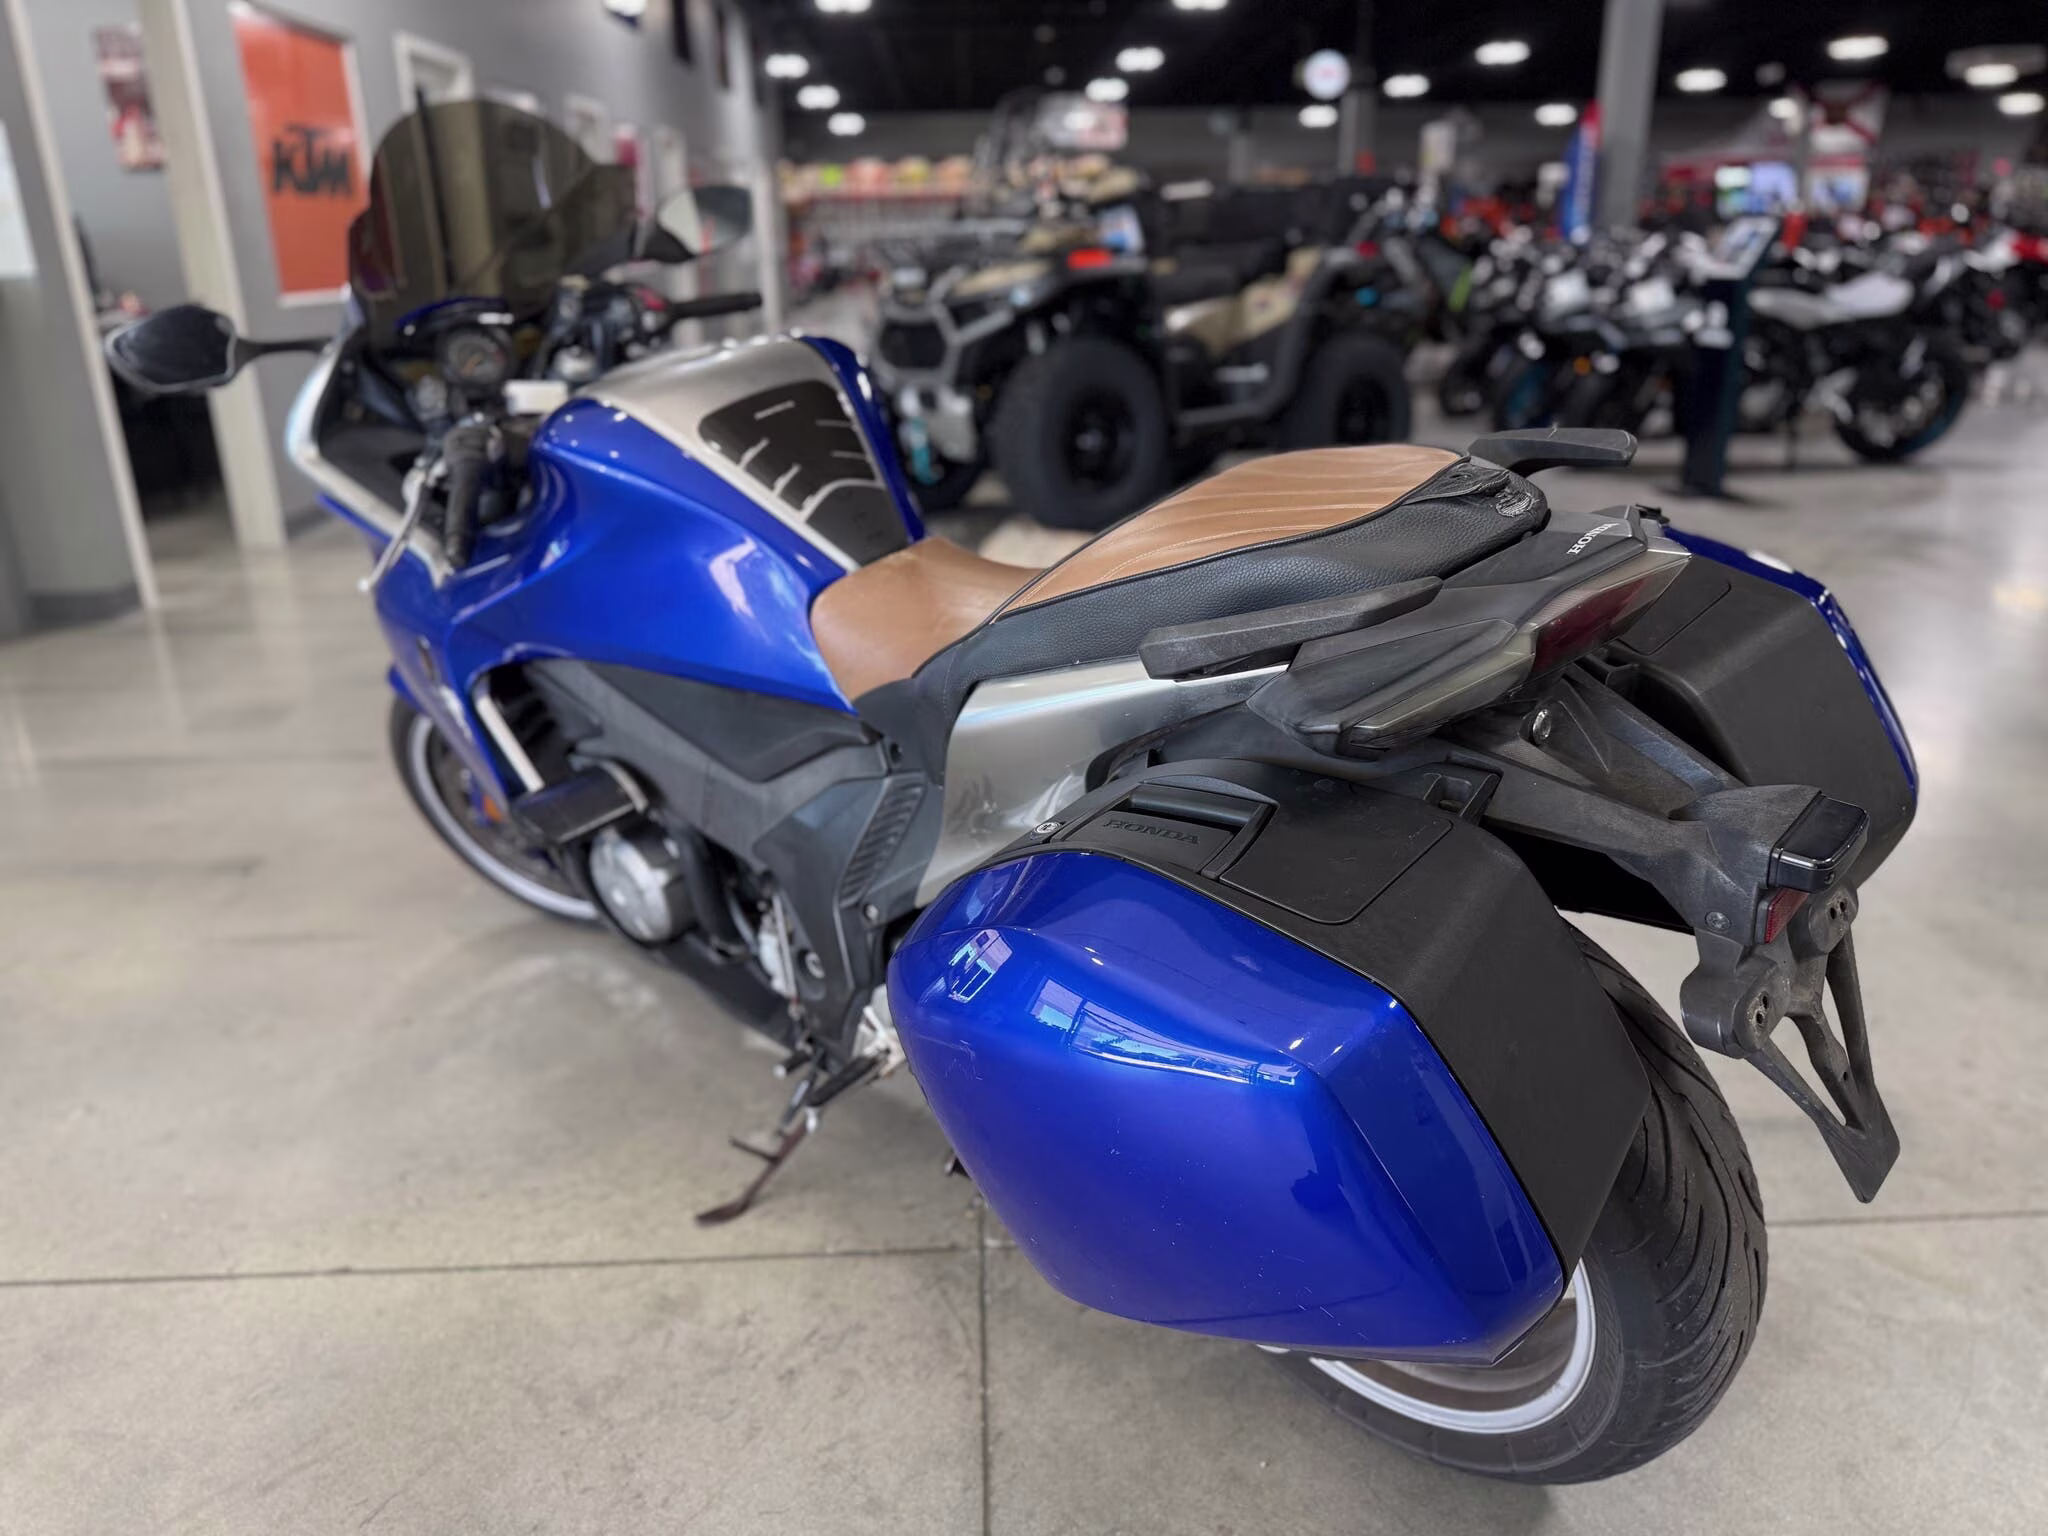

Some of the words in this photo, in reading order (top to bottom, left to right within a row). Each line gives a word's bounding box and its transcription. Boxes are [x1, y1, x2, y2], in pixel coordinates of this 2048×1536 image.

[273, 122, 353, 199] KTM
[1566, 523, 1620, 555] HONDA
[1103, 819, 1200, 845] HONDA
